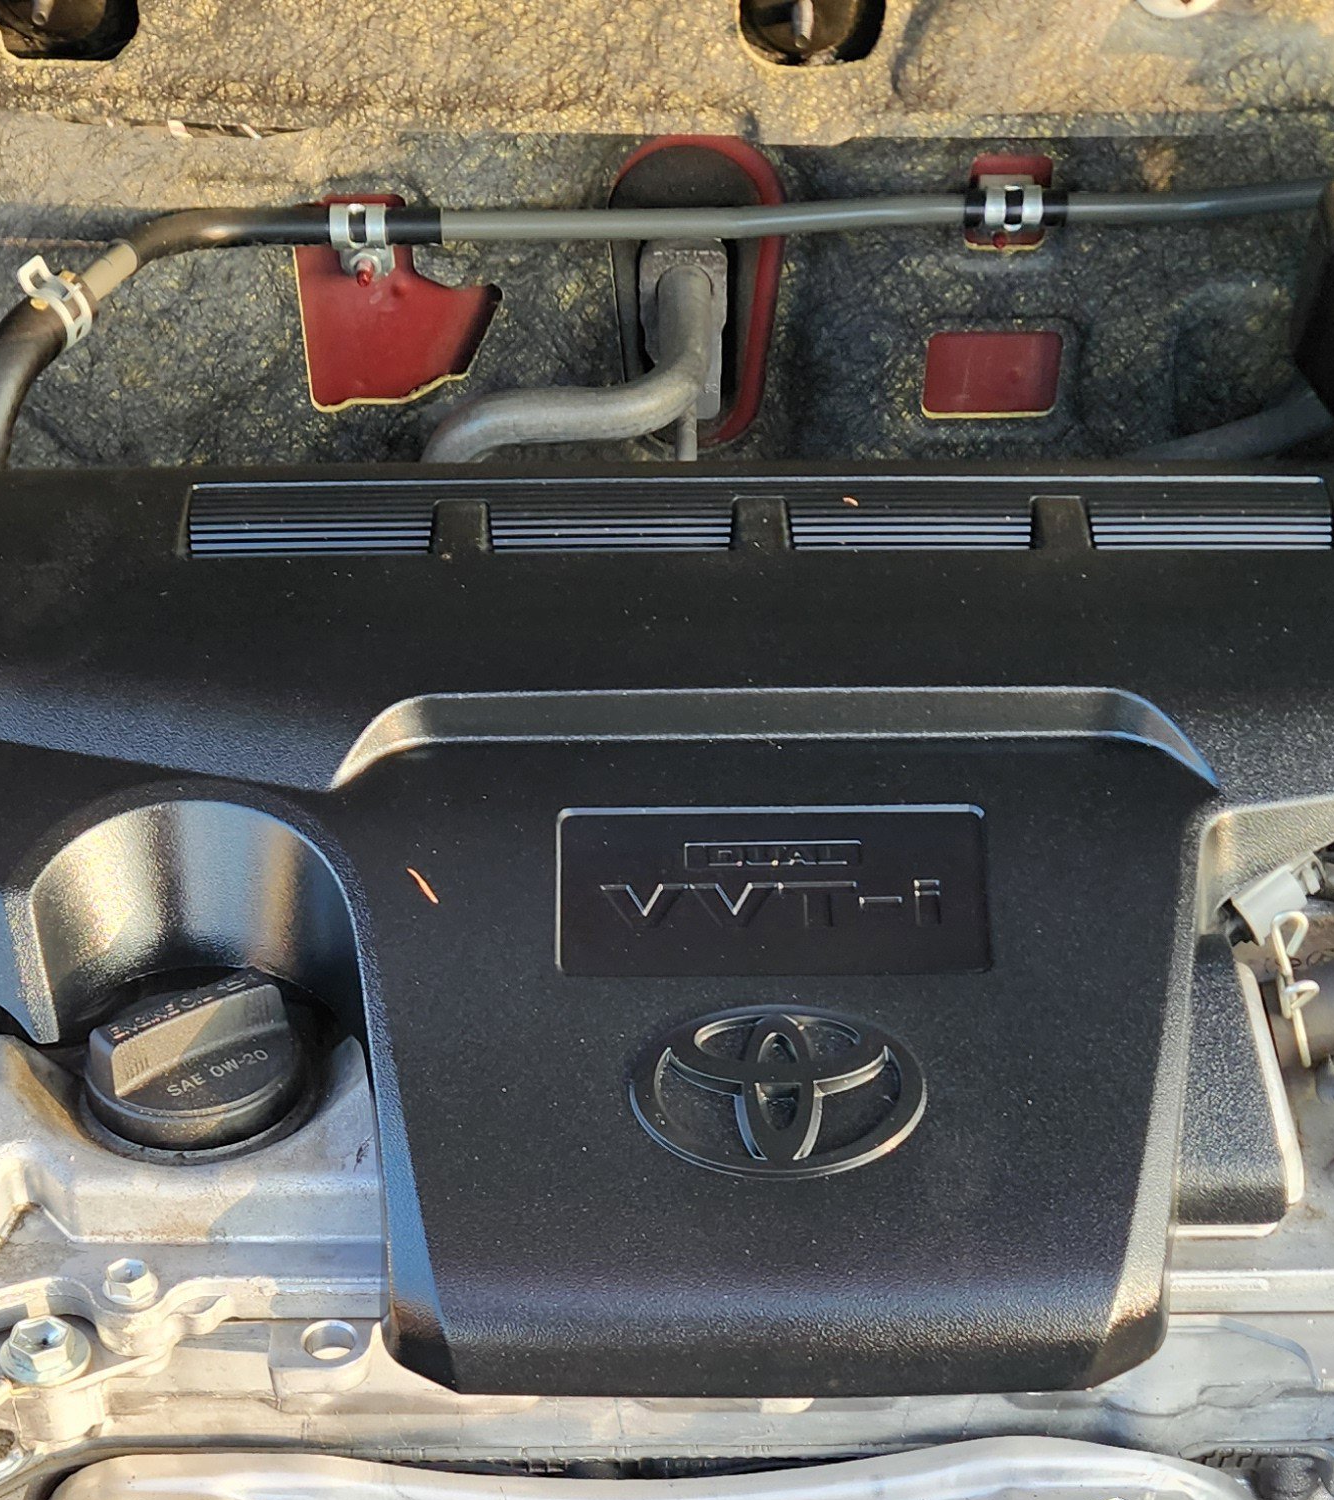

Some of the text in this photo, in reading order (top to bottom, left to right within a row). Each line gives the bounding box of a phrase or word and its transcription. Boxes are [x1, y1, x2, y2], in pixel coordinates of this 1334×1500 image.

[599, 878, 942, 930] VVT-i
[109, 1003, 181, 1040] ENGINE
[167, 1049, 269, 1097] SAE 0W-20
